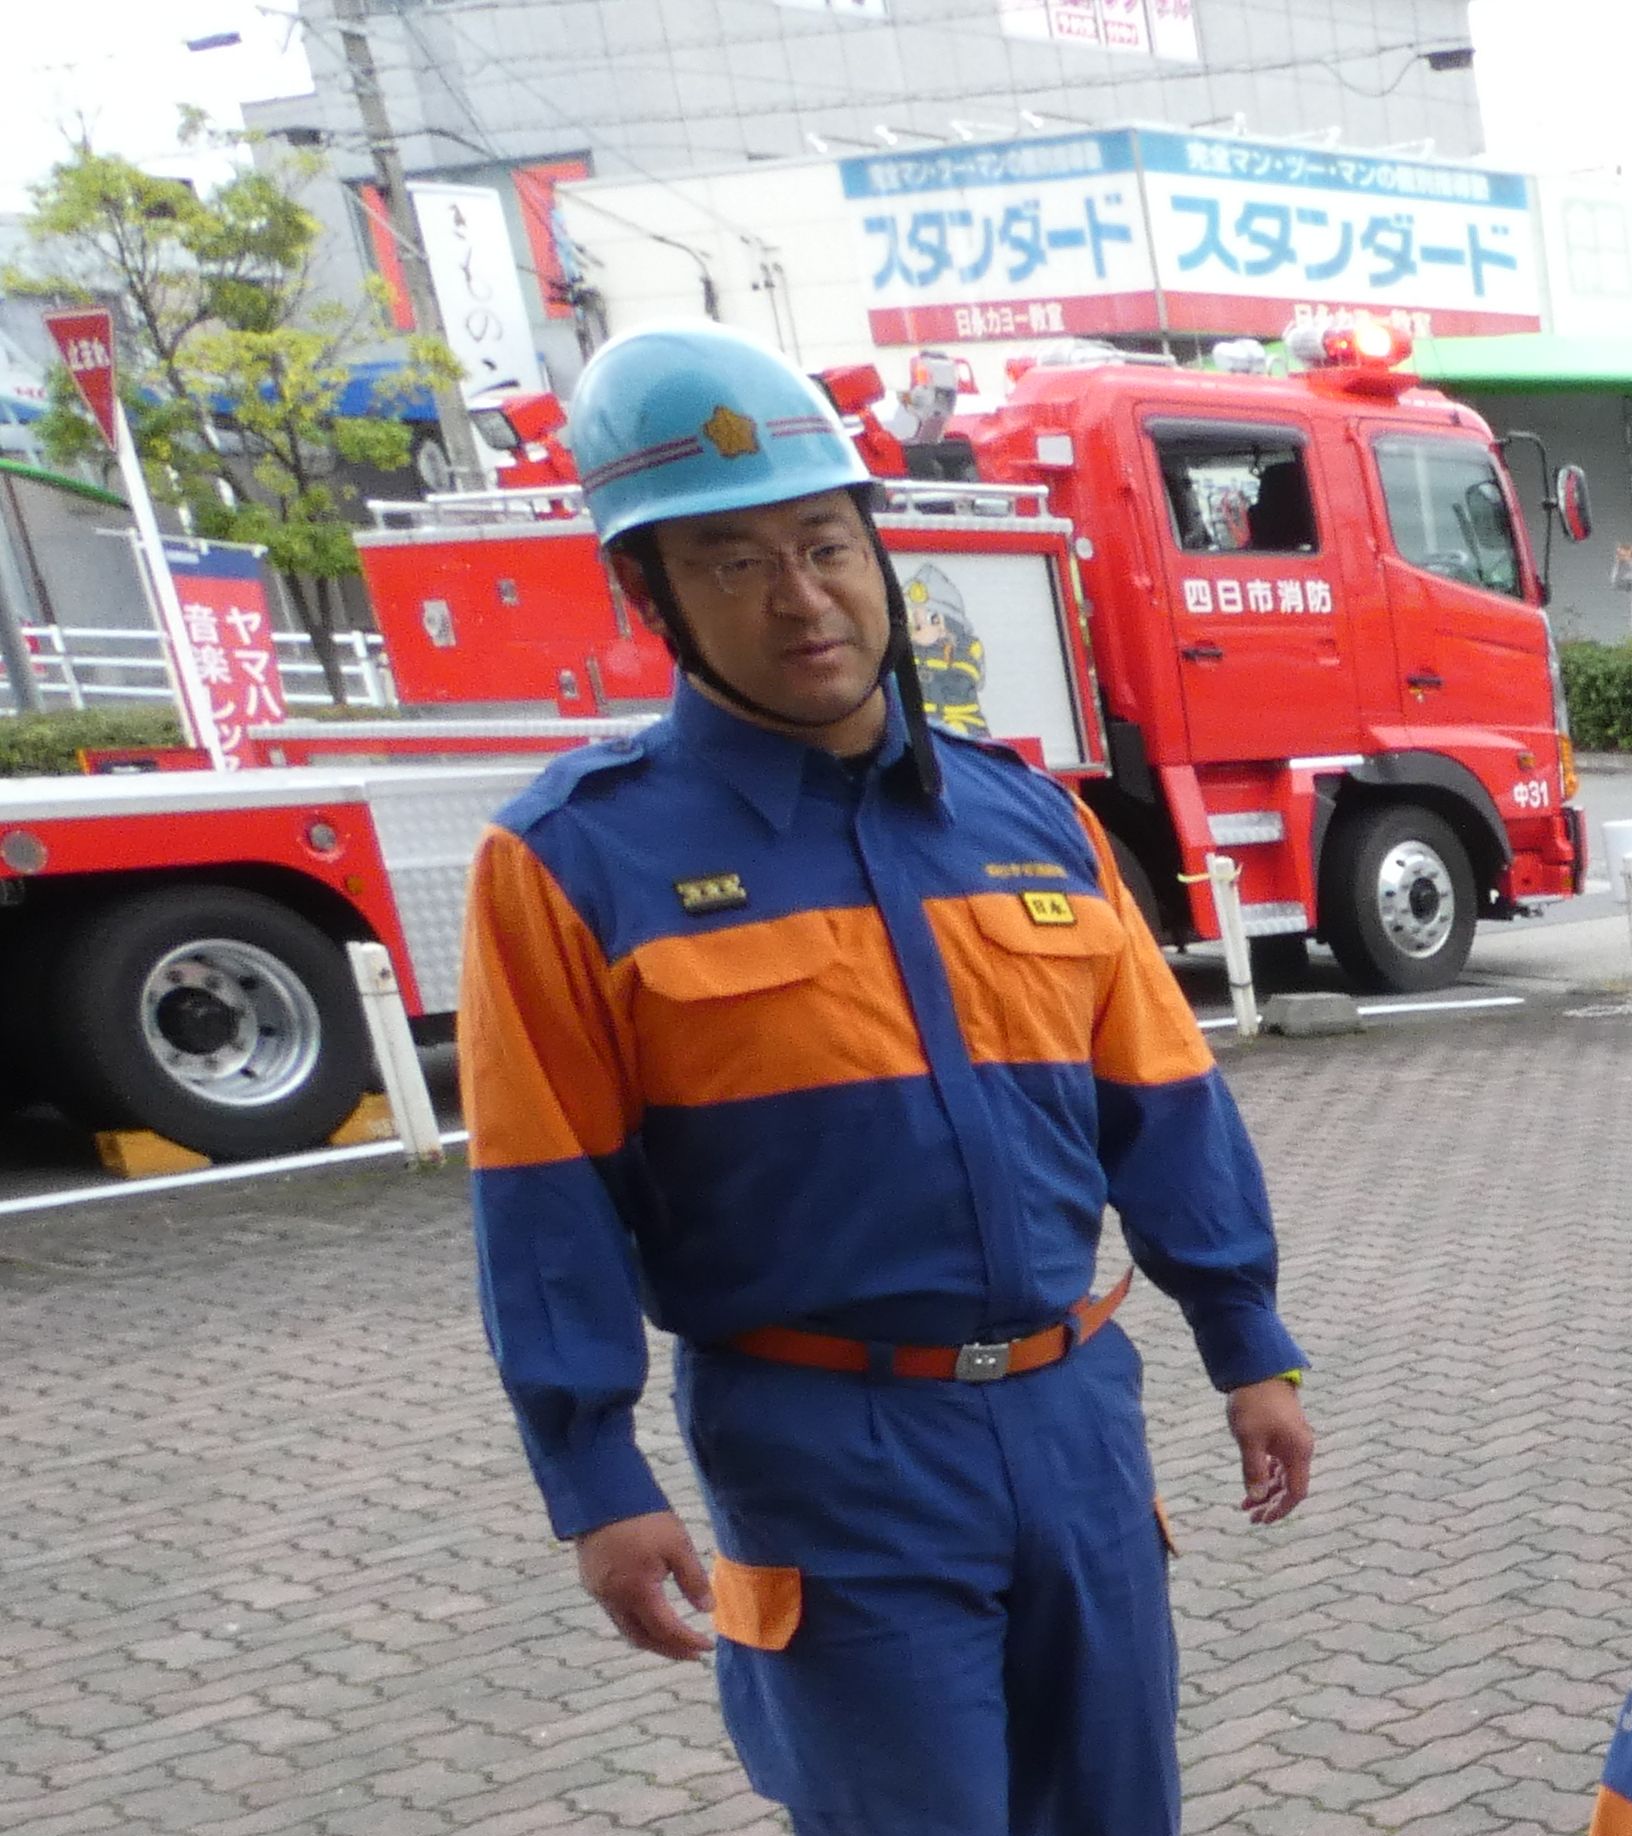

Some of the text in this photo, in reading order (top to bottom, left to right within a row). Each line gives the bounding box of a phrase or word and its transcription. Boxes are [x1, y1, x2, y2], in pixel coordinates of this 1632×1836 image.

[864, 192, 1132, 289] スタンダード
[1170, 194, 1517, 298] スタンダード
[1184, 579, 1332, 613] 四日市消防
[225, 605, 282, 717] ヤマハ
[1513, 780, 1549, 808] 中31
